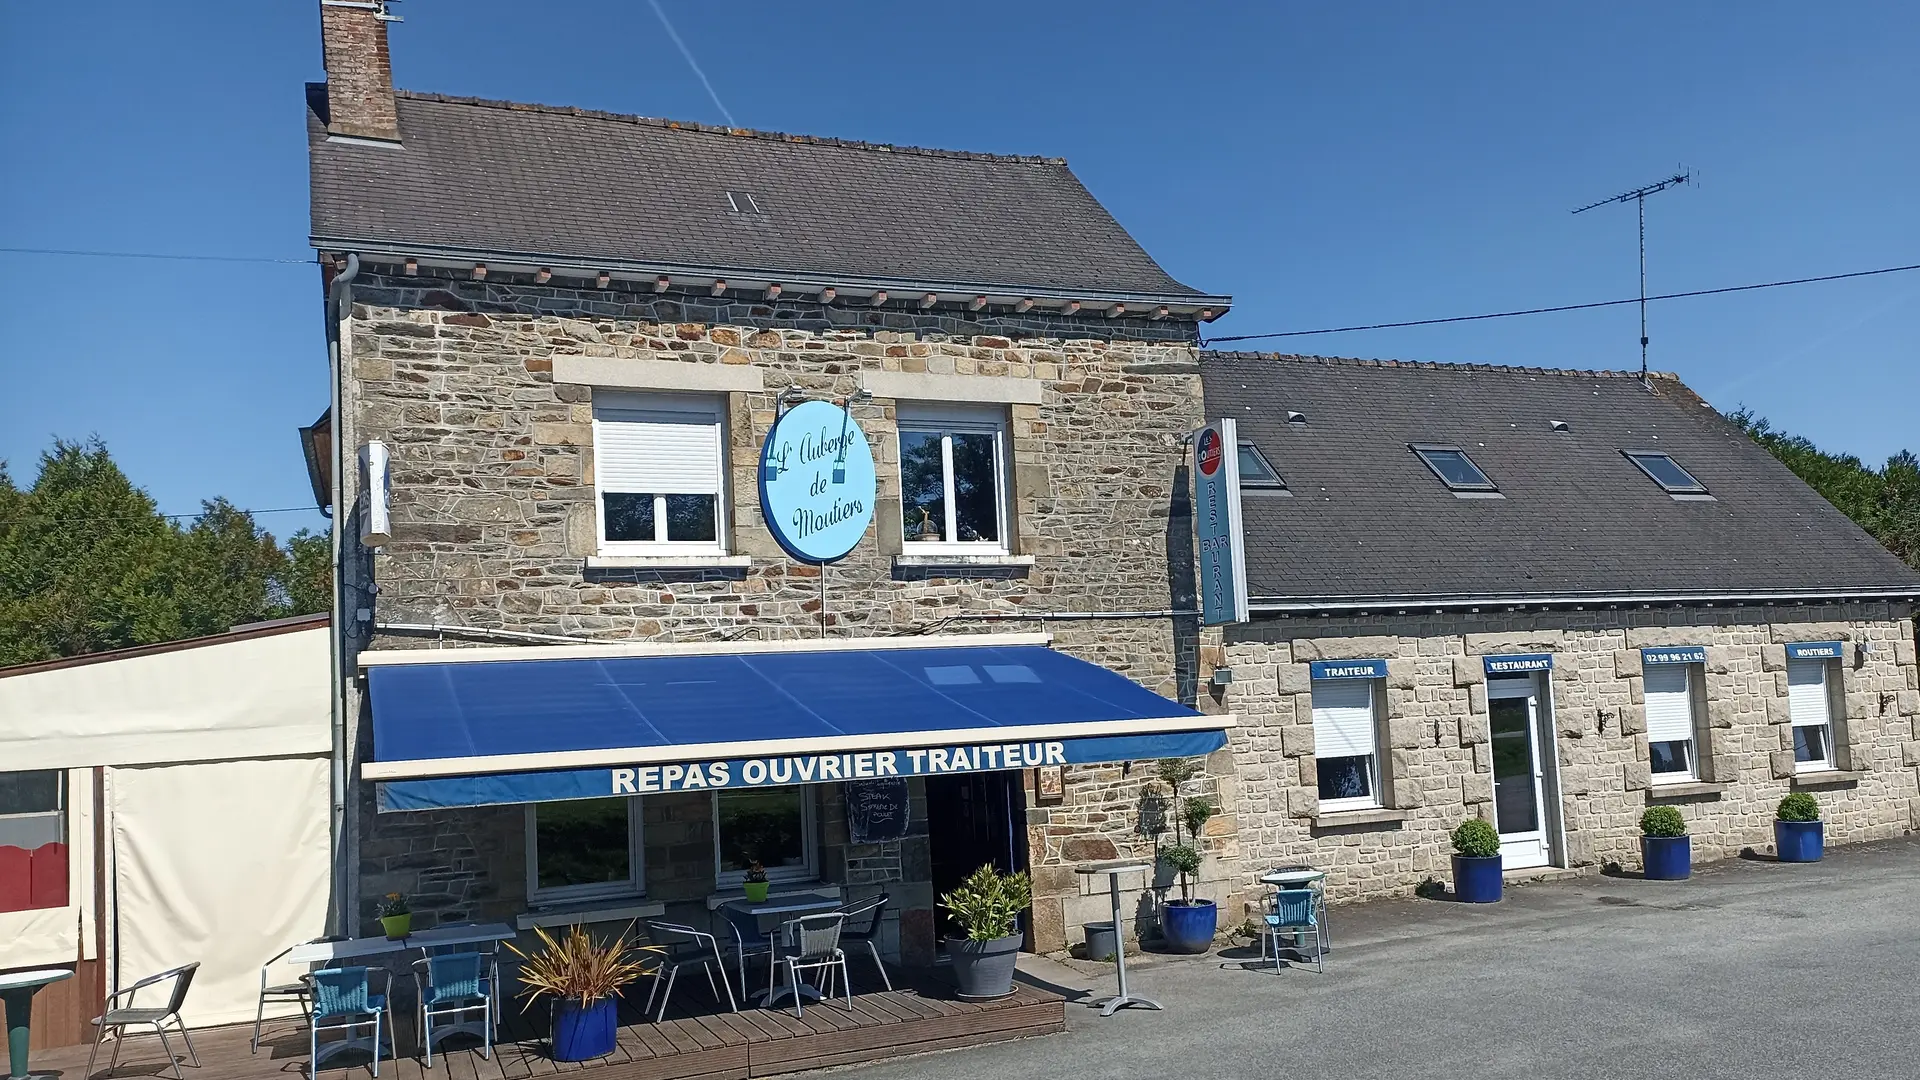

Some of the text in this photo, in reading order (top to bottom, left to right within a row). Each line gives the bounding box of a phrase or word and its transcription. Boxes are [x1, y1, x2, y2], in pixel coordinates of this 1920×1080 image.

[800, 426, 855, 465] Auberge
[810, 471, 827, 497] de
[792, 497, 863, 539] Moutiers
[1202, 535, 1229, 553] BAR
[1207, 481, 1223, 620] RESTAURANT
[1646, 654, 1658, 662] 02
[1658, 653, 1669, 662] 99
[1682, 652, 1692, 661] 21
[1797, 648, 1834, 657] ROUTIERS
[1324, 666, 1375, 677] TRAITEUR
[1490, 660, 1549, 670] RESTAURANT
[611, 741, 1067, 794] REPAS OUVRIER TRAITEUR
